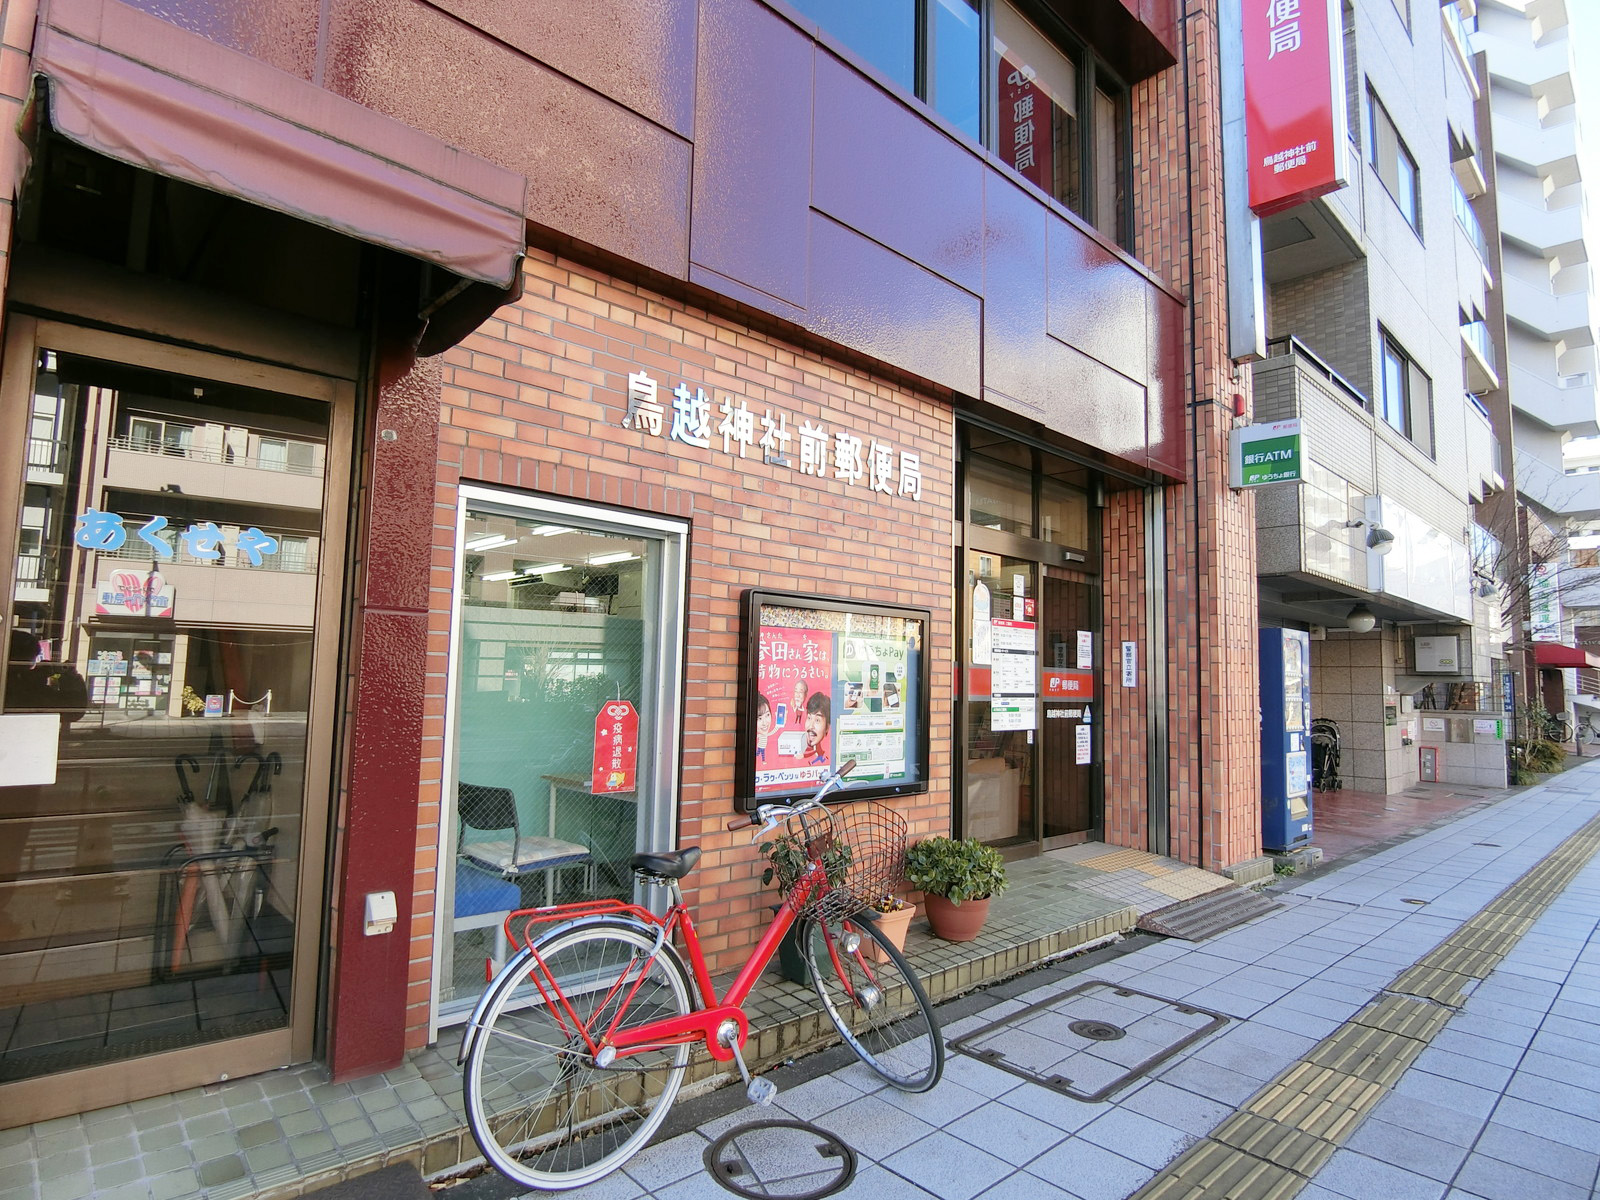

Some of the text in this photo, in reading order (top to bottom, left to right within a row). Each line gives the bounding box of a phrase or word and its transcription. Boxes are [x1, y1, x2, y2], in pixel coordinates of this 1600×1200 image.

[1266, 0, 1301, 61] 便局
[1263, 141, 1317, 168] 鳥越神社前
[1273, 155, 1307, 175] 郵便局
[621, 370, 922, 502] 鳥越神社前郵便局
[1245, 450, 1292, 465] 銀行ATM
[1262, 471, 1296, 480] ゆうちょ銀行
[74, 507, 279, 567] あくせや
[1062, 680, 1079, 691] 郵便局
[611, 722, 623, 769] 疫病退散
